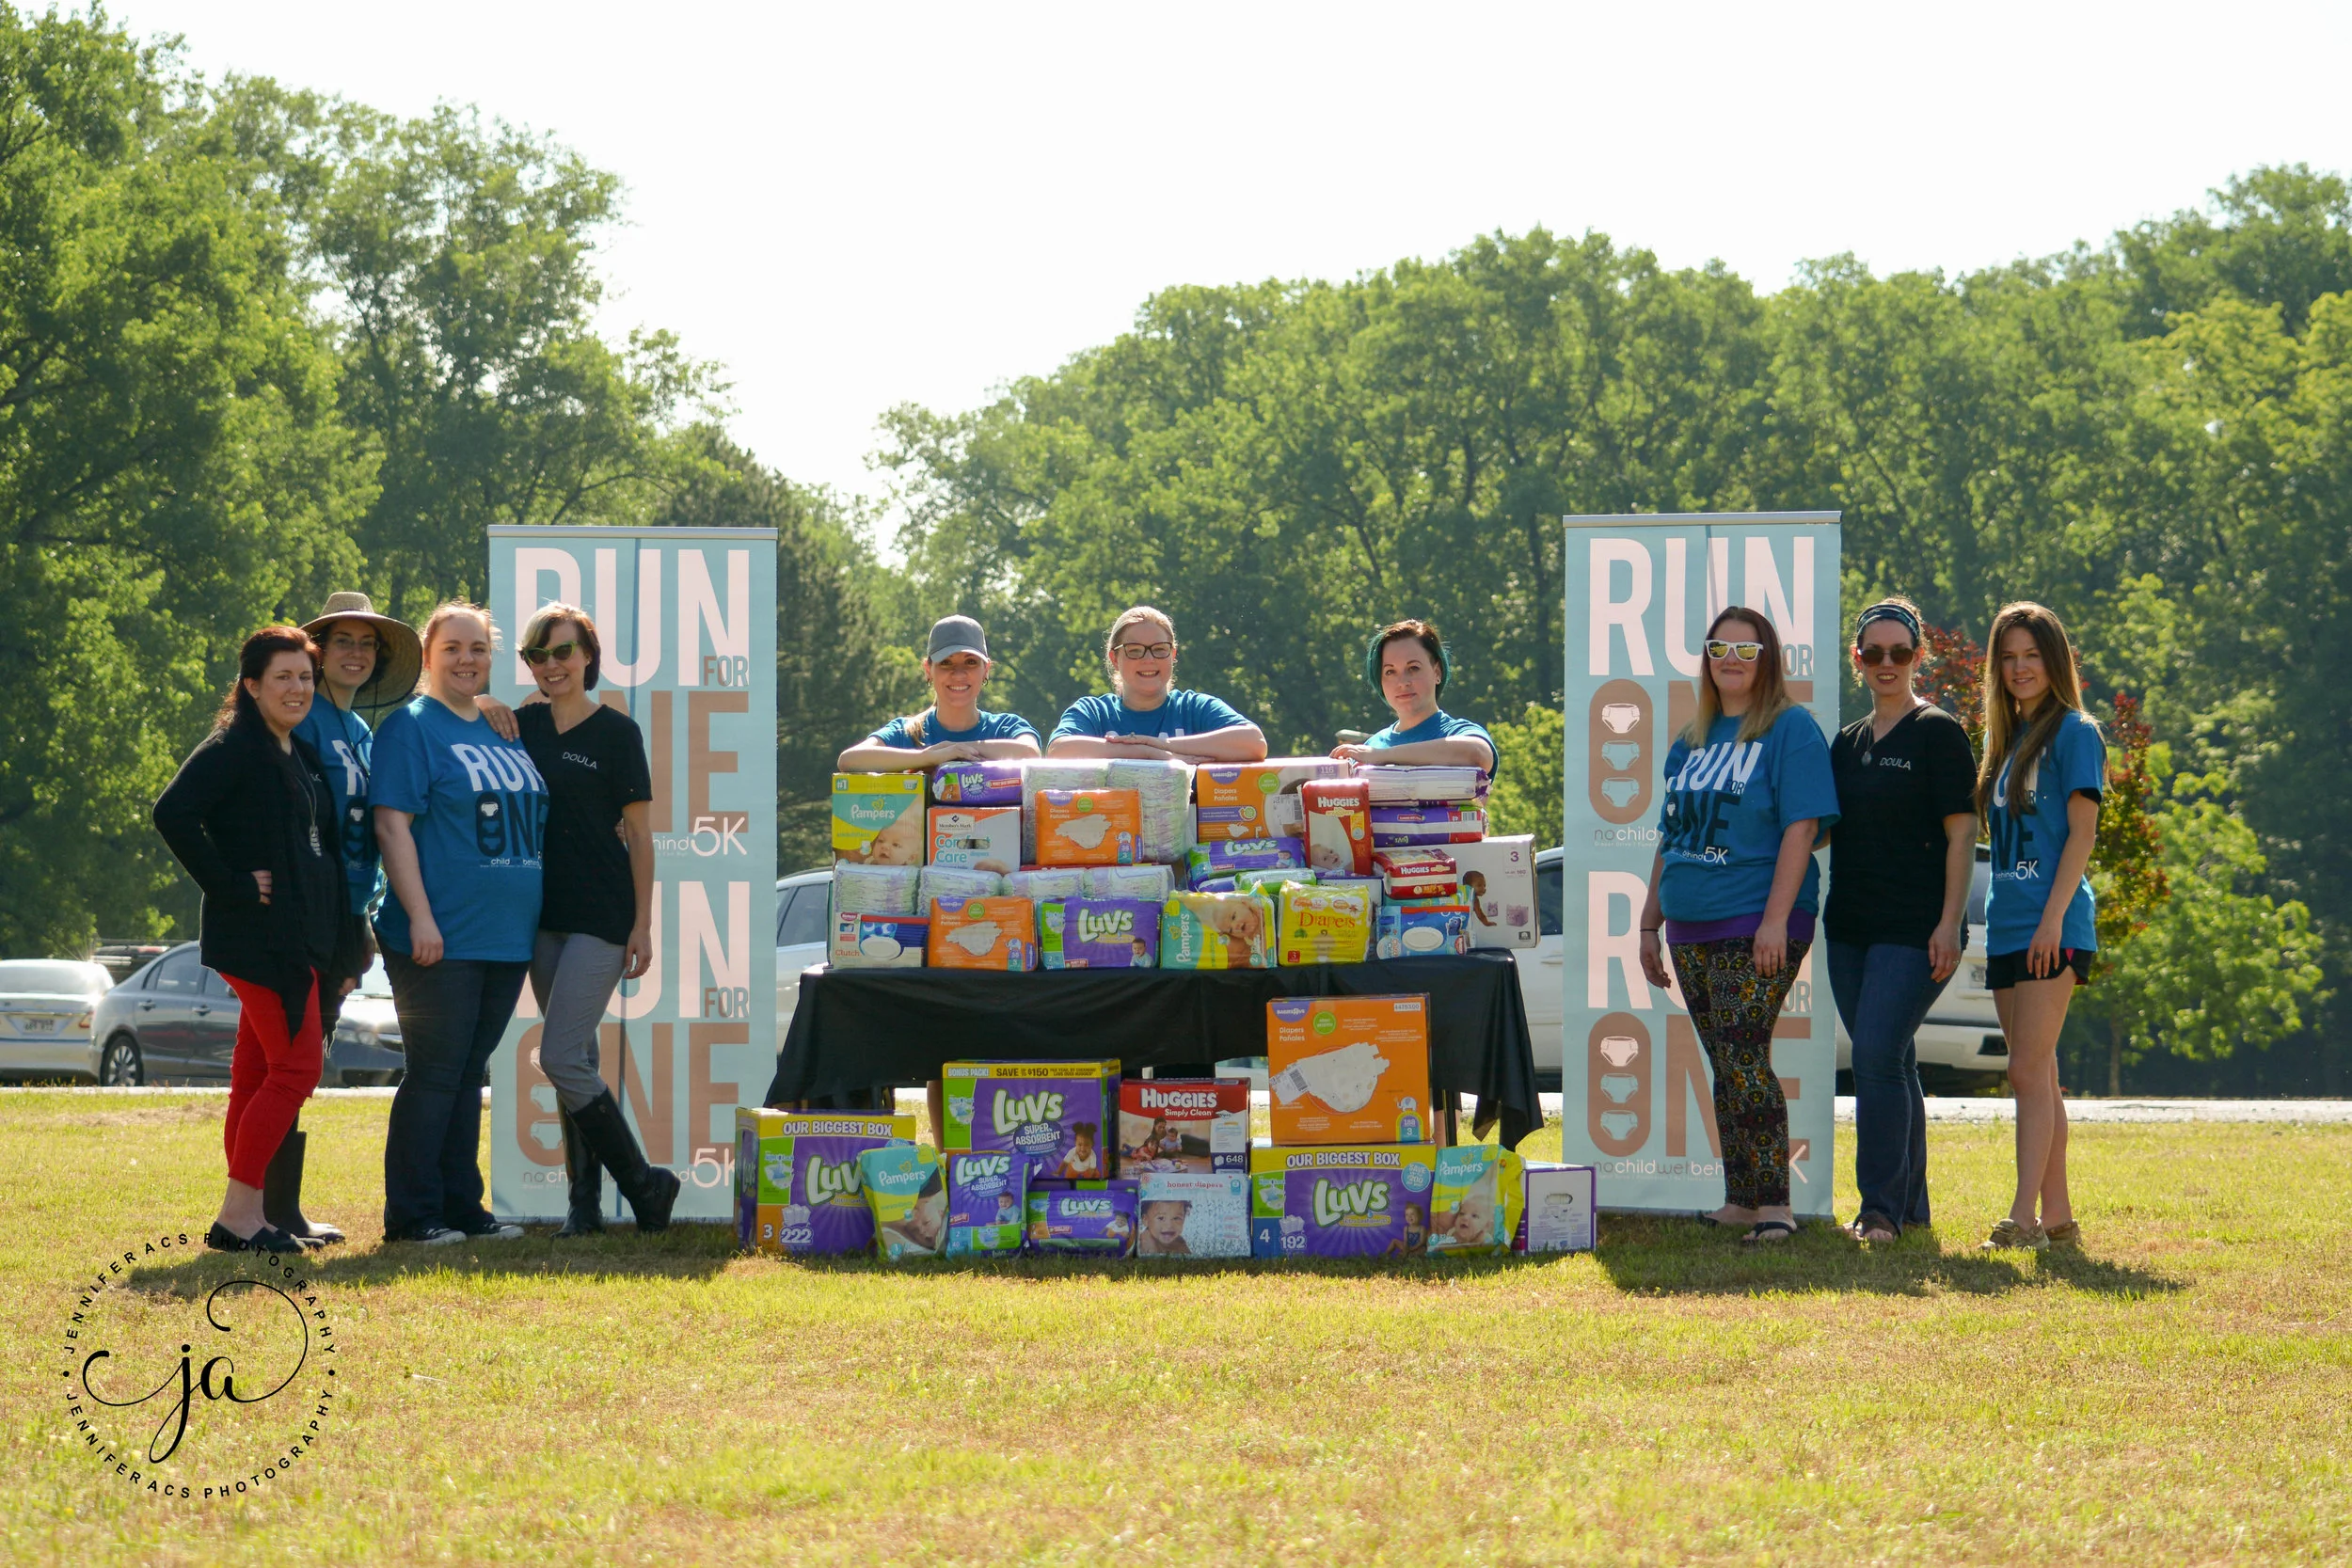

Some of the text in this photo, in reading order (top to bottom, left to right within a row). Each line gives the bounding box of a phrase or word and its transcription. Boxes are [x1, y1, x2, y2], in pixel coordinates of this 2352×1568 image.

[1588, 536, 1814, 676] RUN
[515, 547, 749, 687] RUN
[1783, 644, 1812, 675] OR
[703, 656, 749, 687] FOR
[451, 743, 545, 792] RUN
[562, 752, 597, 769] DOULA
[1880, 757, 1912, 770] DOULA
[836, 780, 847, 789] #1
[1317, 797, 1359, 808] HUGGIES
[850, 804, 895, 820] Pampers
[691, 816, 748, 856] 5K
[935, 850, 967, 863] Care
[1510, 851, 1519, 862] 3
[1704, 847, 1728, 865] 5K
[2015, 860, 2040, 880] 5K
[1299, 911, 1356, 928] Diapers
[1176, 913, 1192, 962] Pampers
[705, 987, 749, 1018] FOR
[1279, 1034, 1305, 1042] Pañales
[947, 1068, 969, 1077] BONUS
[996, 1069, 1019, 1077] SAVE
[1028, 1069, 1049, 1077] $150
[1141, 1087, 1217, 1108] HUGGIES
[1165, 1108, 1212, 1117] Simply Clean
[783, 1120, 893, 1137] OUR BIGGEST BOX
[1406, 1128, 1413, 1136] 3
[1015, 1131, 1061, 1146] ABSORBENT
[1226, 1154, 1244, 1164] 648
[1286, 1151, 1401, 1167] OUR BIGGEST BOX
[1439, 1161, 1484, 1177] Pampers
[806, 1155, 863, 1208] Luv
[879, 1170, 927, 1187] Pampers
[971, 1180, 1008, 1192] ABSORBENT
[1195, 1180, 1223, 1189] diapers
[763, 1225, 773, 1239] 3
[781, 1227, 813, 1244] 222
[1259, 1228, 1270, 1243] 4
[1279, 1236, 1306, 1249] 192
